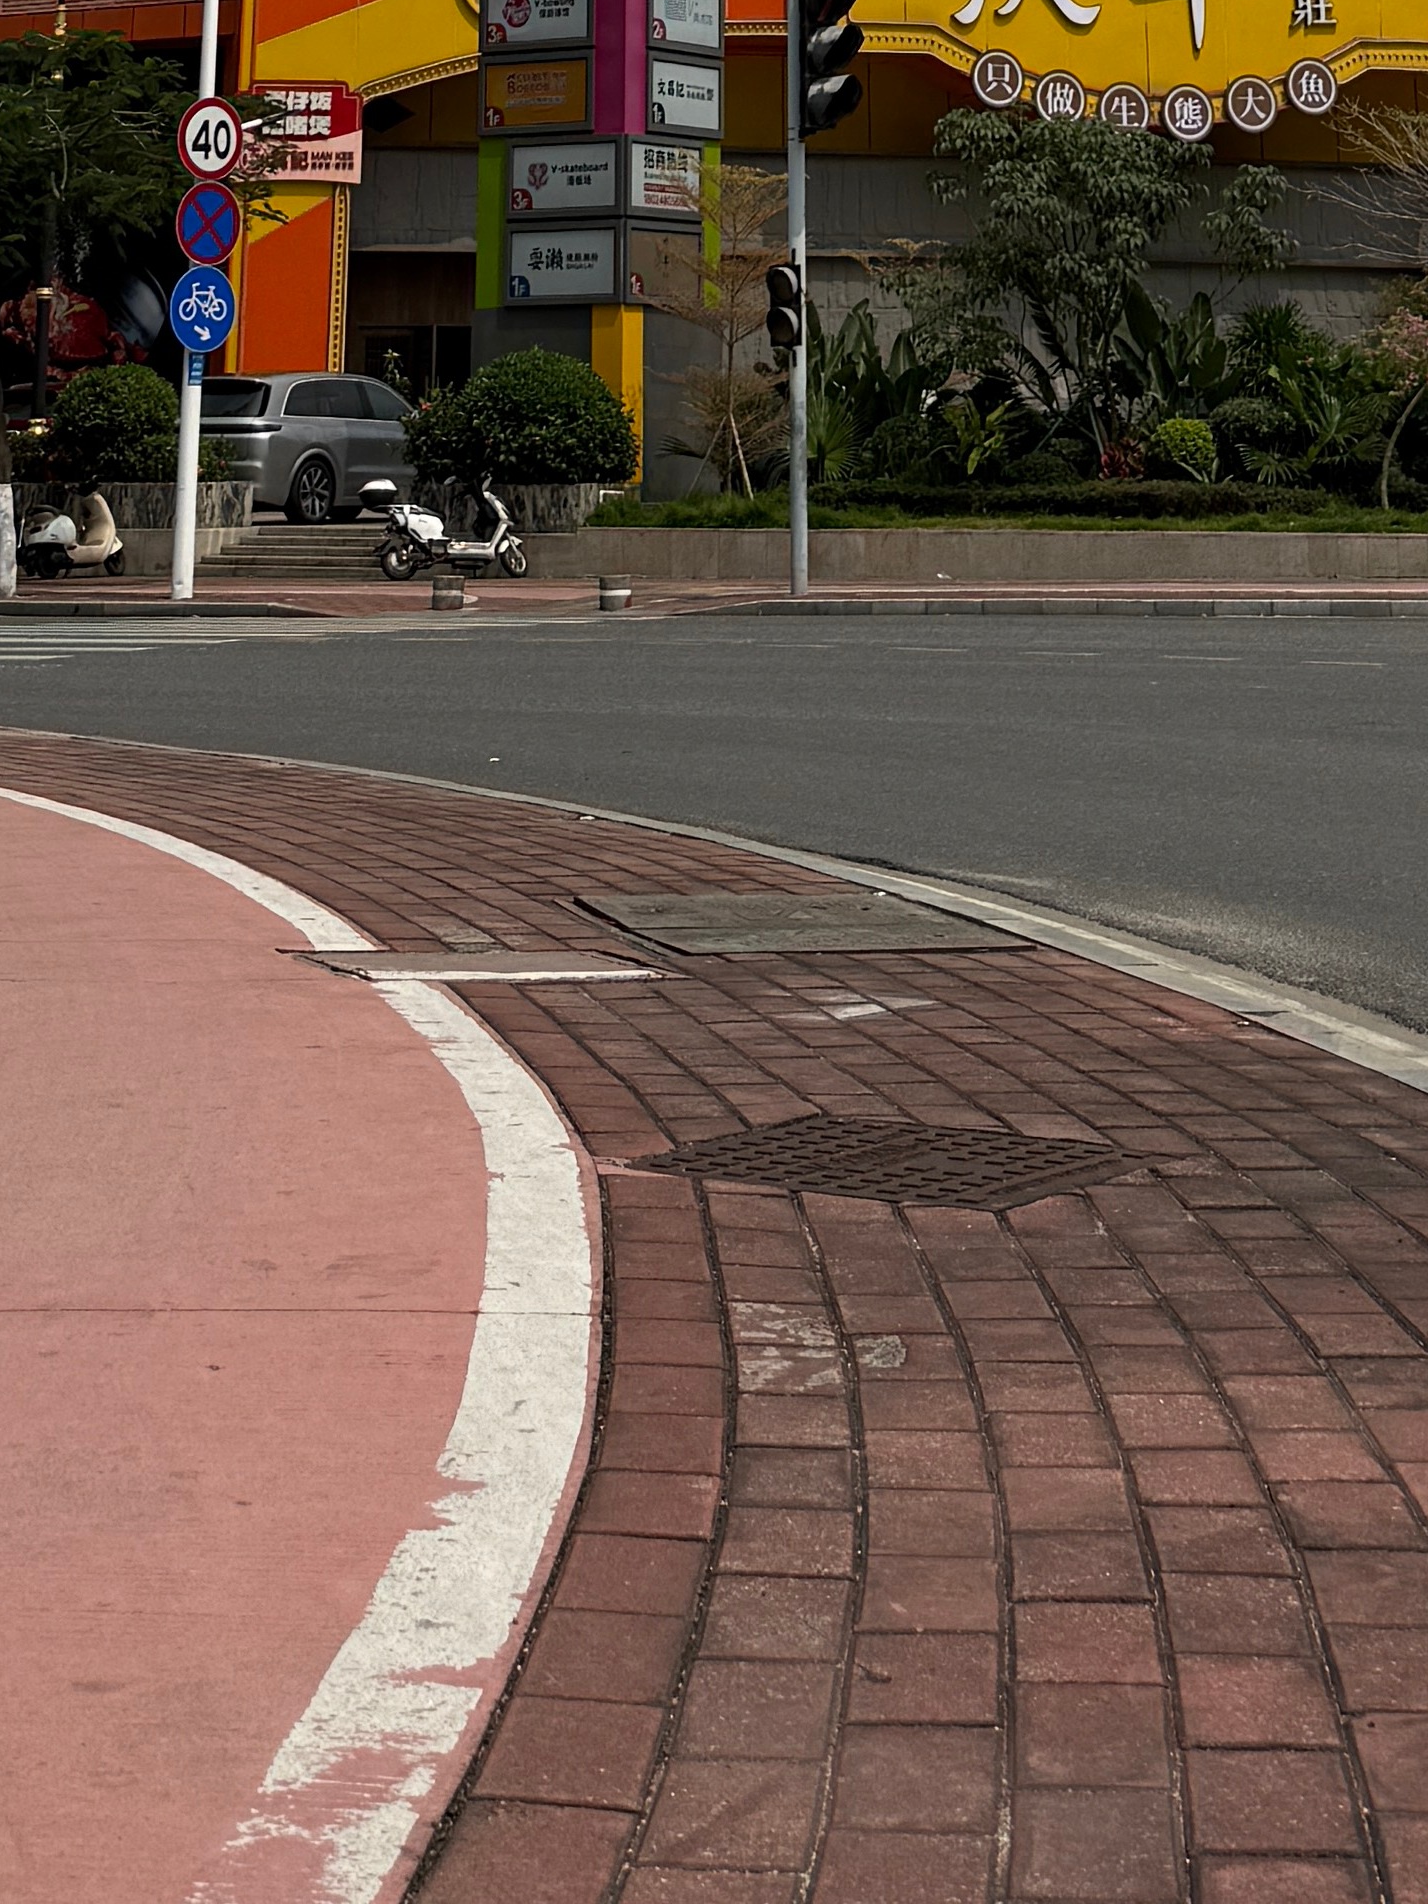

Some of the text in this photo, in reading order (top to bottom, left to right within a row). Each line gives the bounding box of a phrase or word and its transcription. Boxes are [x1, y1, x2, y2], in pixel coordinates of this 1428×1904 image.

[488, 25, 502, 43] 3F
[985, 61, 1329, 130] 只做生態大魚
[486, 107, 500, 126] 1F
[192, 119, 231, 160] 40
[513, 190, 529, 210] 3F
[511, 277, 526, 296] 1F
